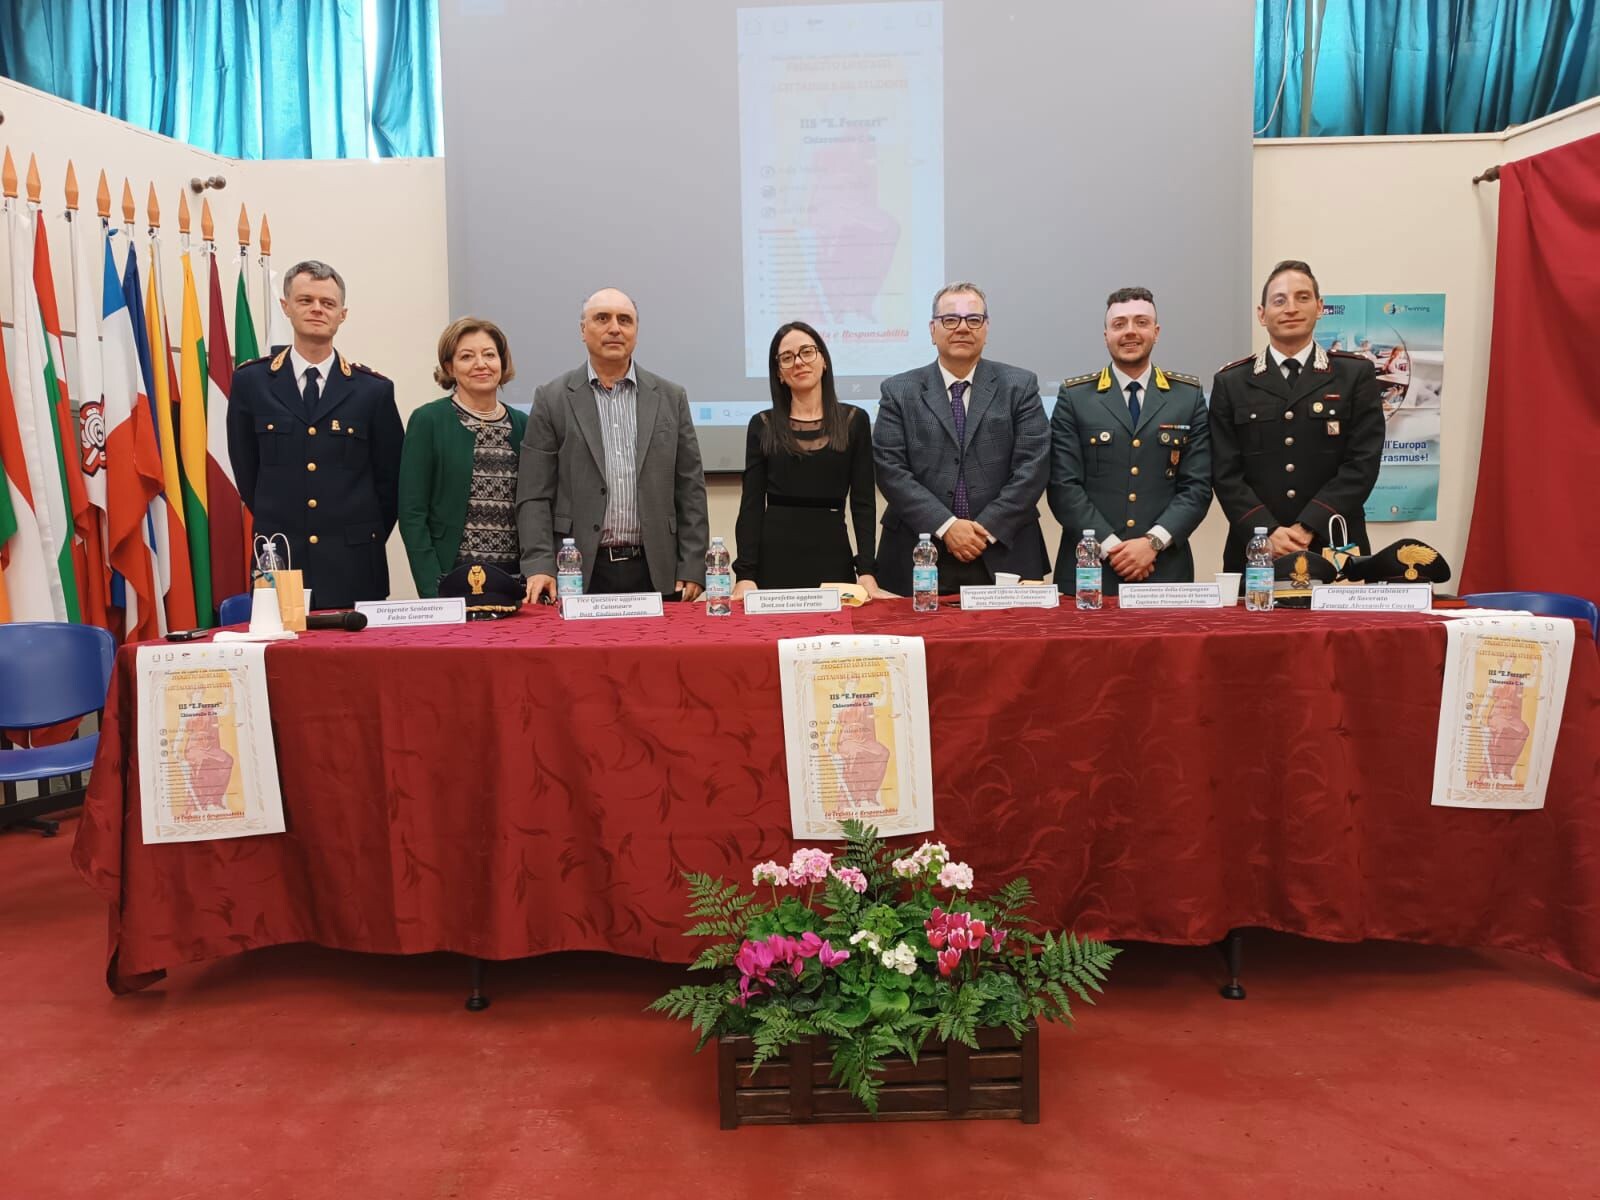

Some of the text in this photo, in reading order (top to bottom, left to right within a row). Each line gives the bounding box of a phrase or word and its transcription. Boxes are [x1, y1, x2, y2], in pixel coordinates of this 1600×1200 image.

[1383, 440, 1427, 451] ll'Europa
[1383, 453, 1429, 462] rasmus+!
[829, 693, 840, 701] IIS
